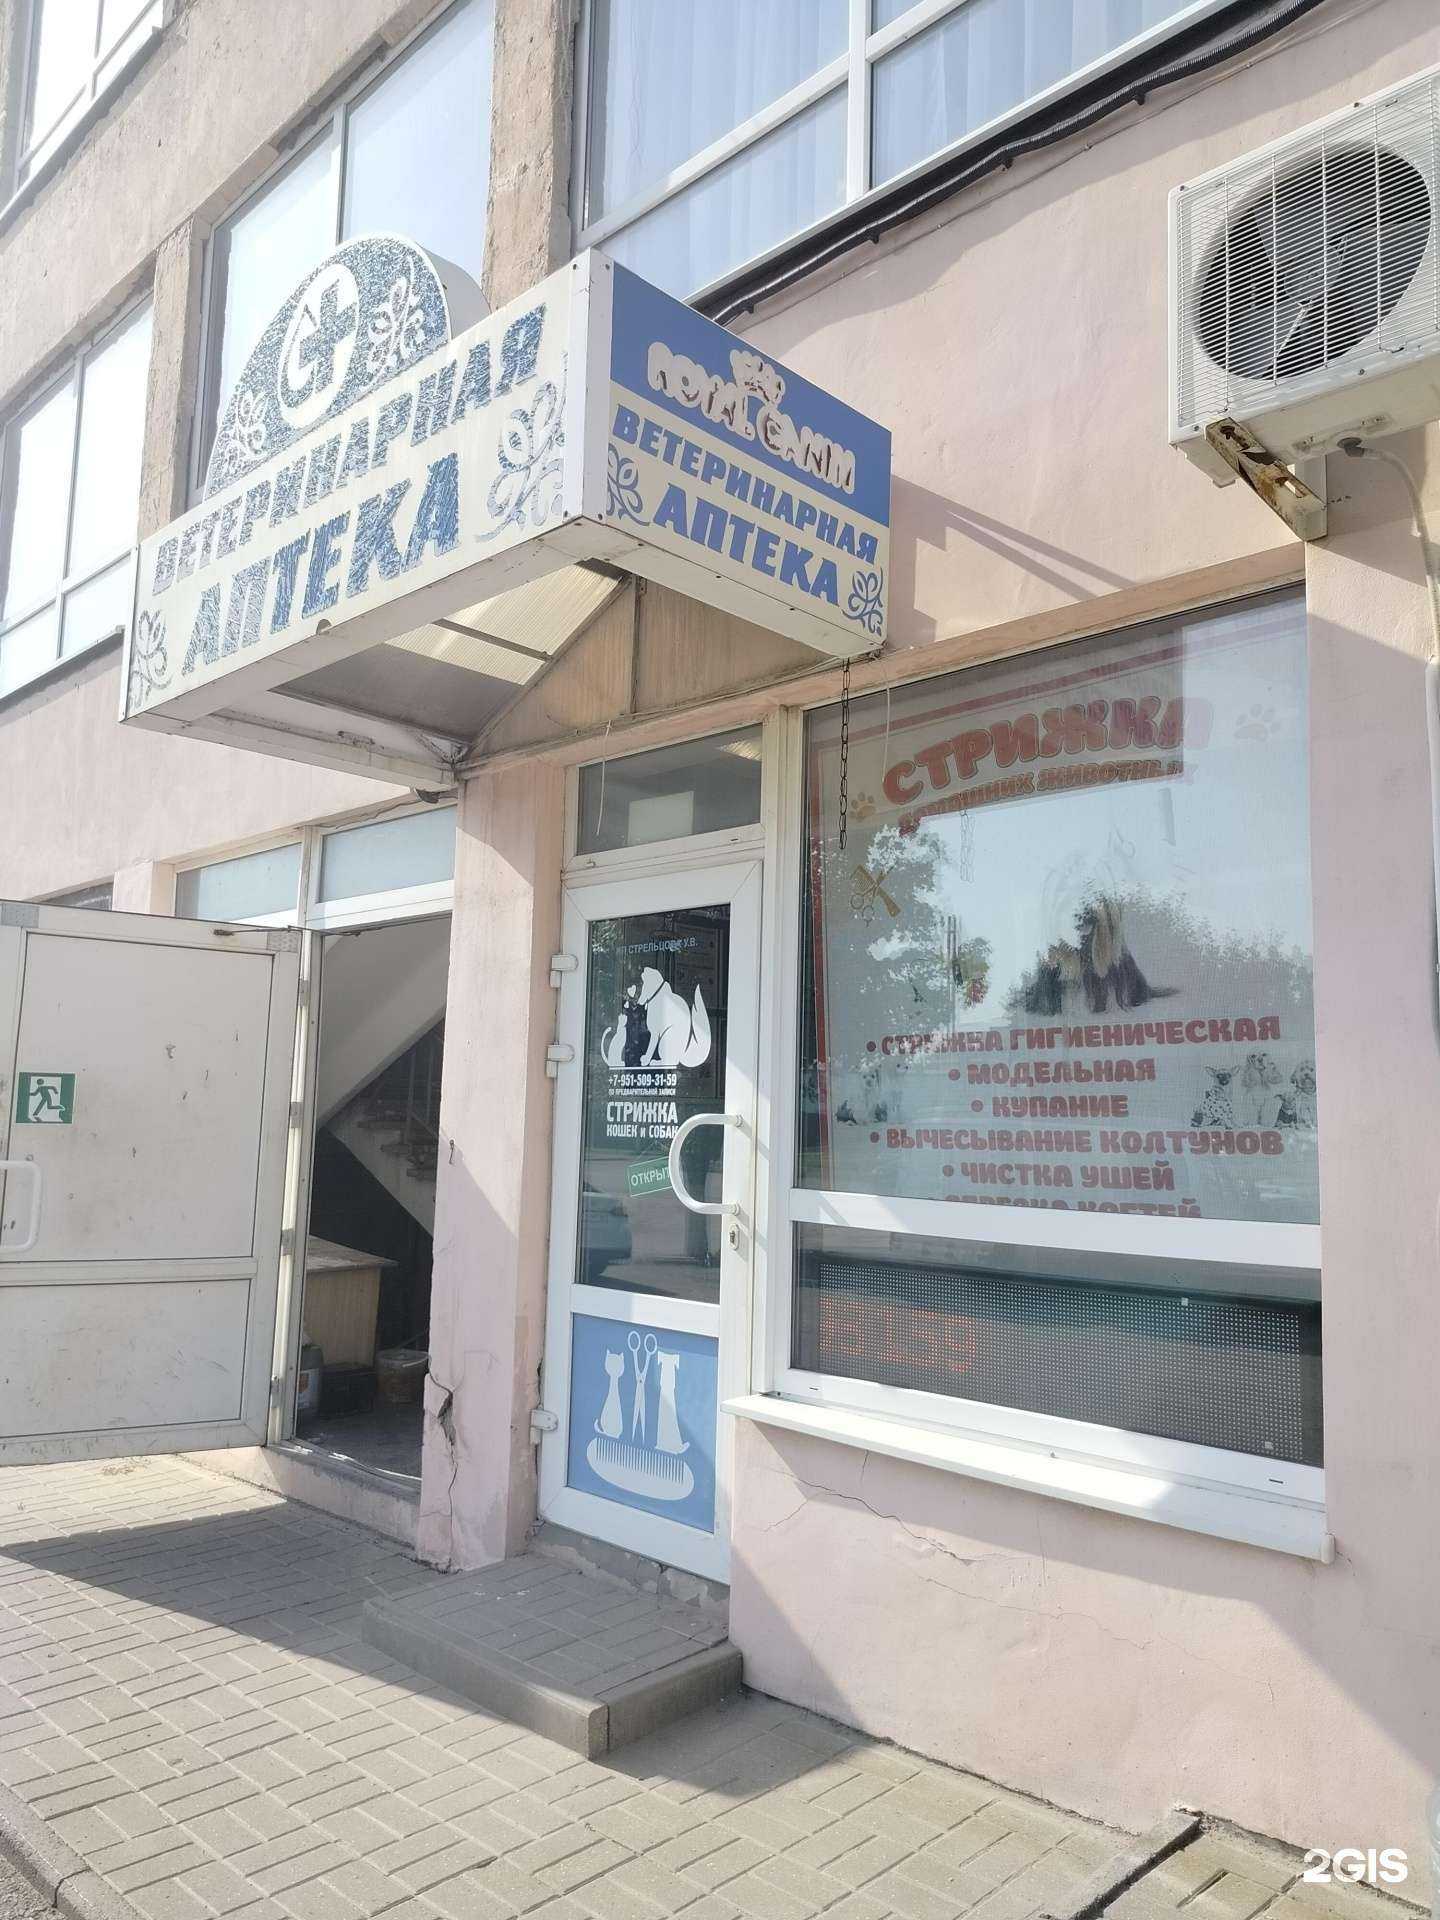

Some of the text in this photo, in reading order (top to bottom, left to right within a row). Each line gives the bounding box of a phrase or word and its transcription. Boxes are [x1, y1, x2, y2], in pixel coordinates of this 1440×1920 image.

[153, 303, 547, 596] ВЕТЕРИНАРНАЯ
[612, 404, 878, 565] ВЕТЕРИНАРНАЯ
[653, 482, 840, 607] АПТЕКА
[182, 452, 461, 676] АПТЕКА
[883, 696, 1213, 805] СТРИЖКА
[1009, 1015, 1281, 1051] ГИГИЕНИЧЕСКАЯ
[608, 1073, 678, 1087] +7-951-509-31-59
[967, 1058, 1156, 1087] МОДЕЛЬНАЯ
[606, 1101, 679, 1124] СТРИЖКА
[992, 1095, 1129, 1118] КУПАНИЕ
[606, 1124, 639, 1138] КОШЕК
[886, 1129, 1284, 1155] ВЫЧЕСЫВАНИЕ КОЛТУНОВ
[961, 1159, 1175, 1191] ЧИСТКА УШЕЙ
